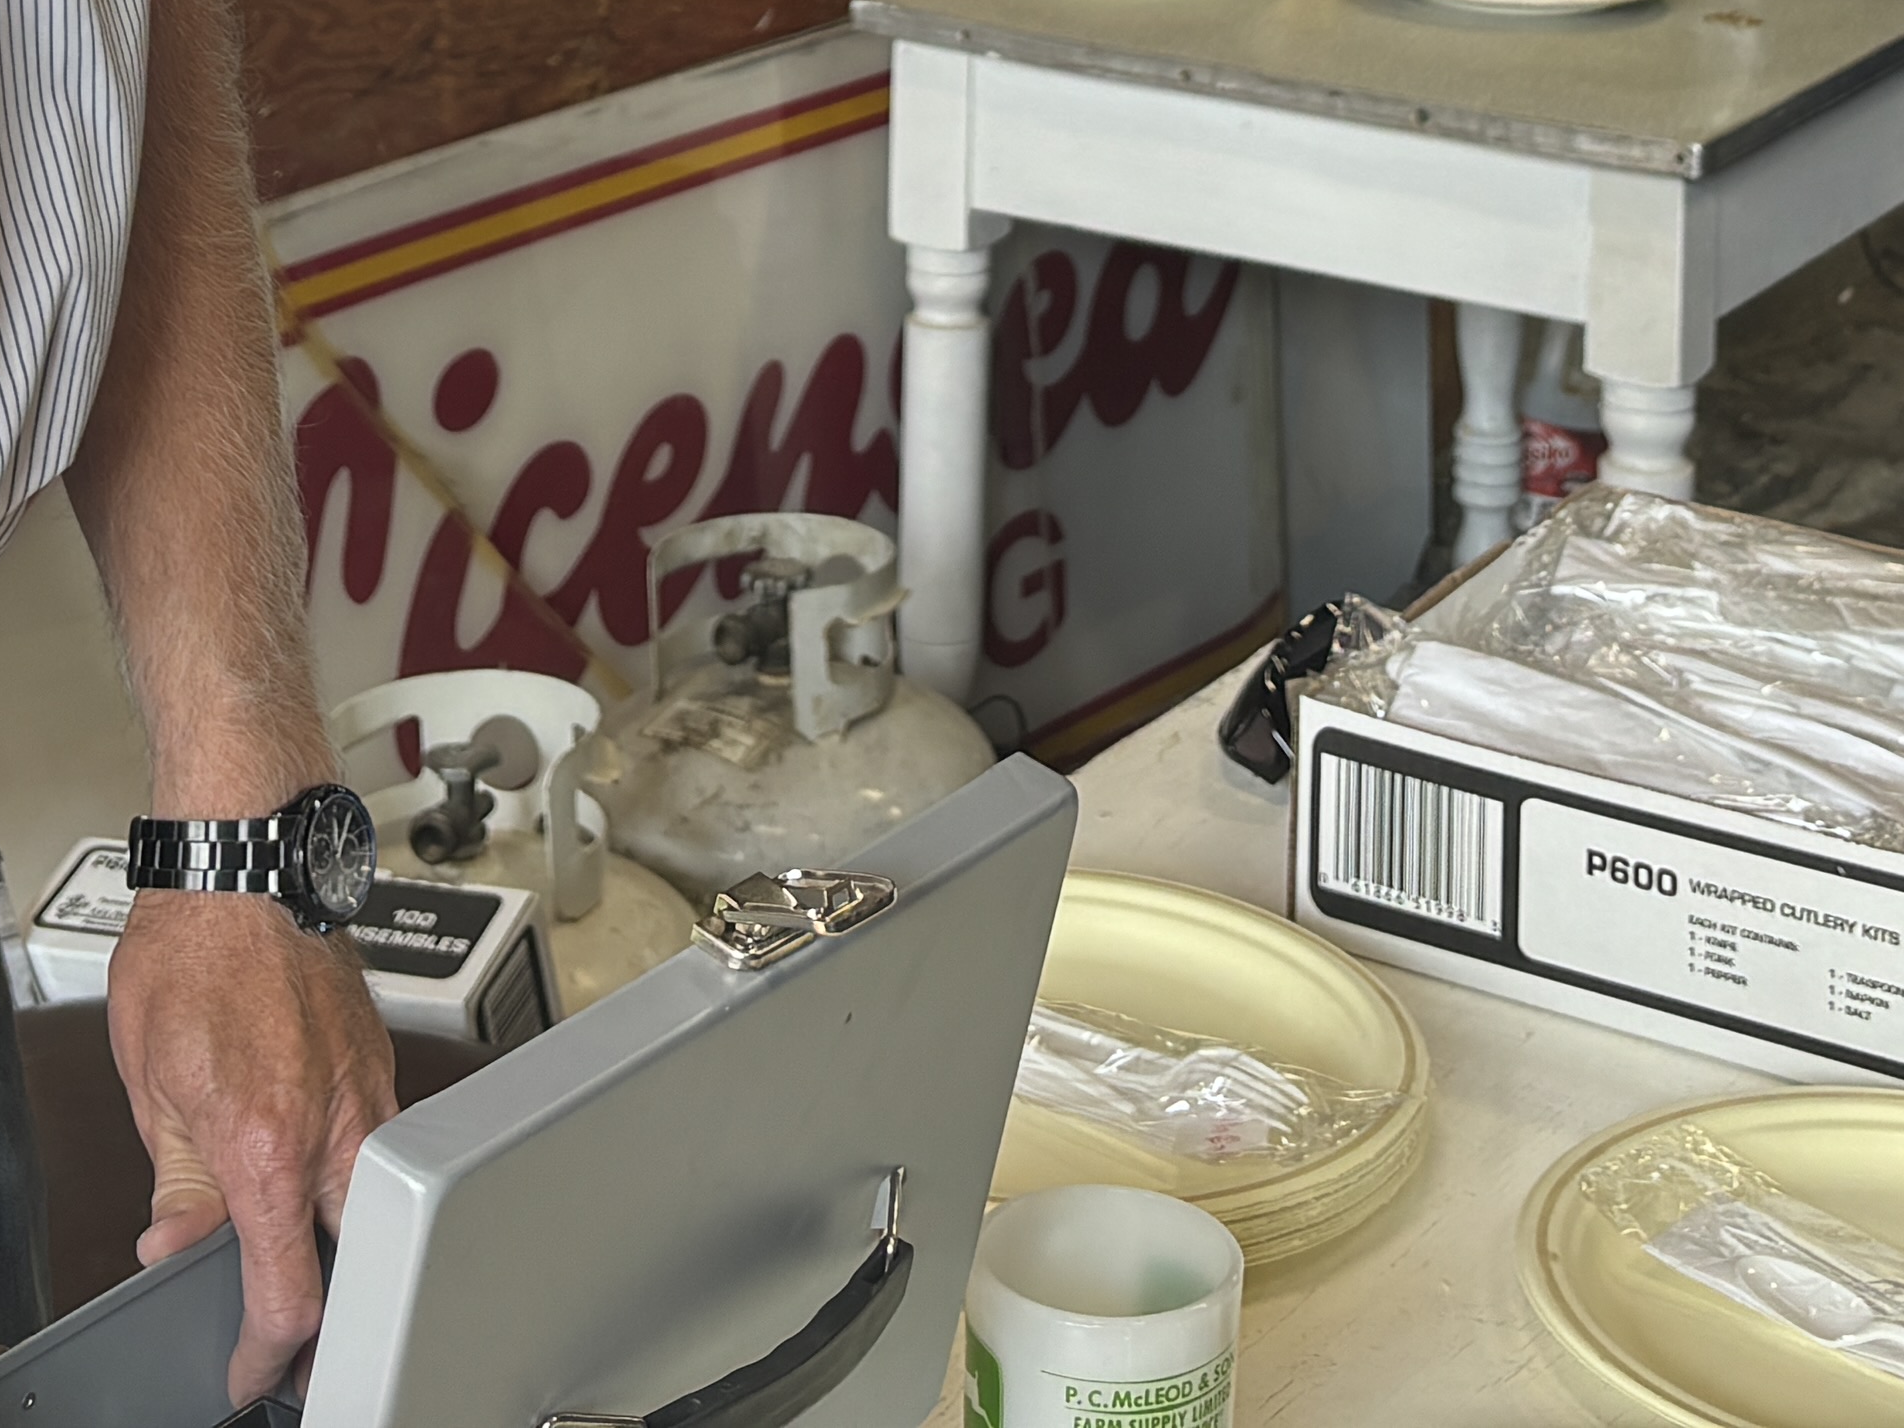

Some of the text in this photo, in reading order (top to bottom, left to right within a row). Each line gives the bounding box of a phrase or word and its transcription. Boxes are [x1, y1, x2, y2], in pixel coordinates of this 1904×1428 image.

[1585, 847, 1901, 947] P600 WRAPPED CUTLERY KITS
[392, 907, 438, 930] 100
[1688, 914, 1718, 931] EACH
[346, 923, 471, 955] NSEMBLES
[1688, 930, 1696, 941] 1
[1688, 946, 1696, 957] 1
[1688, 962, 1696, 973] 1
[1704, 966, 1749, 986] PEPPER
[1828, 968, 1836, 979] 1
[1828, 984, 1835, 995] 1
[1828, 1000, 1835, 1011] 1
[1065, 1385, 1082, 1405] P.
[1198, 1372, 1210, 1391] &
[1128, 1410, 1187, 1428] SUPPLY
